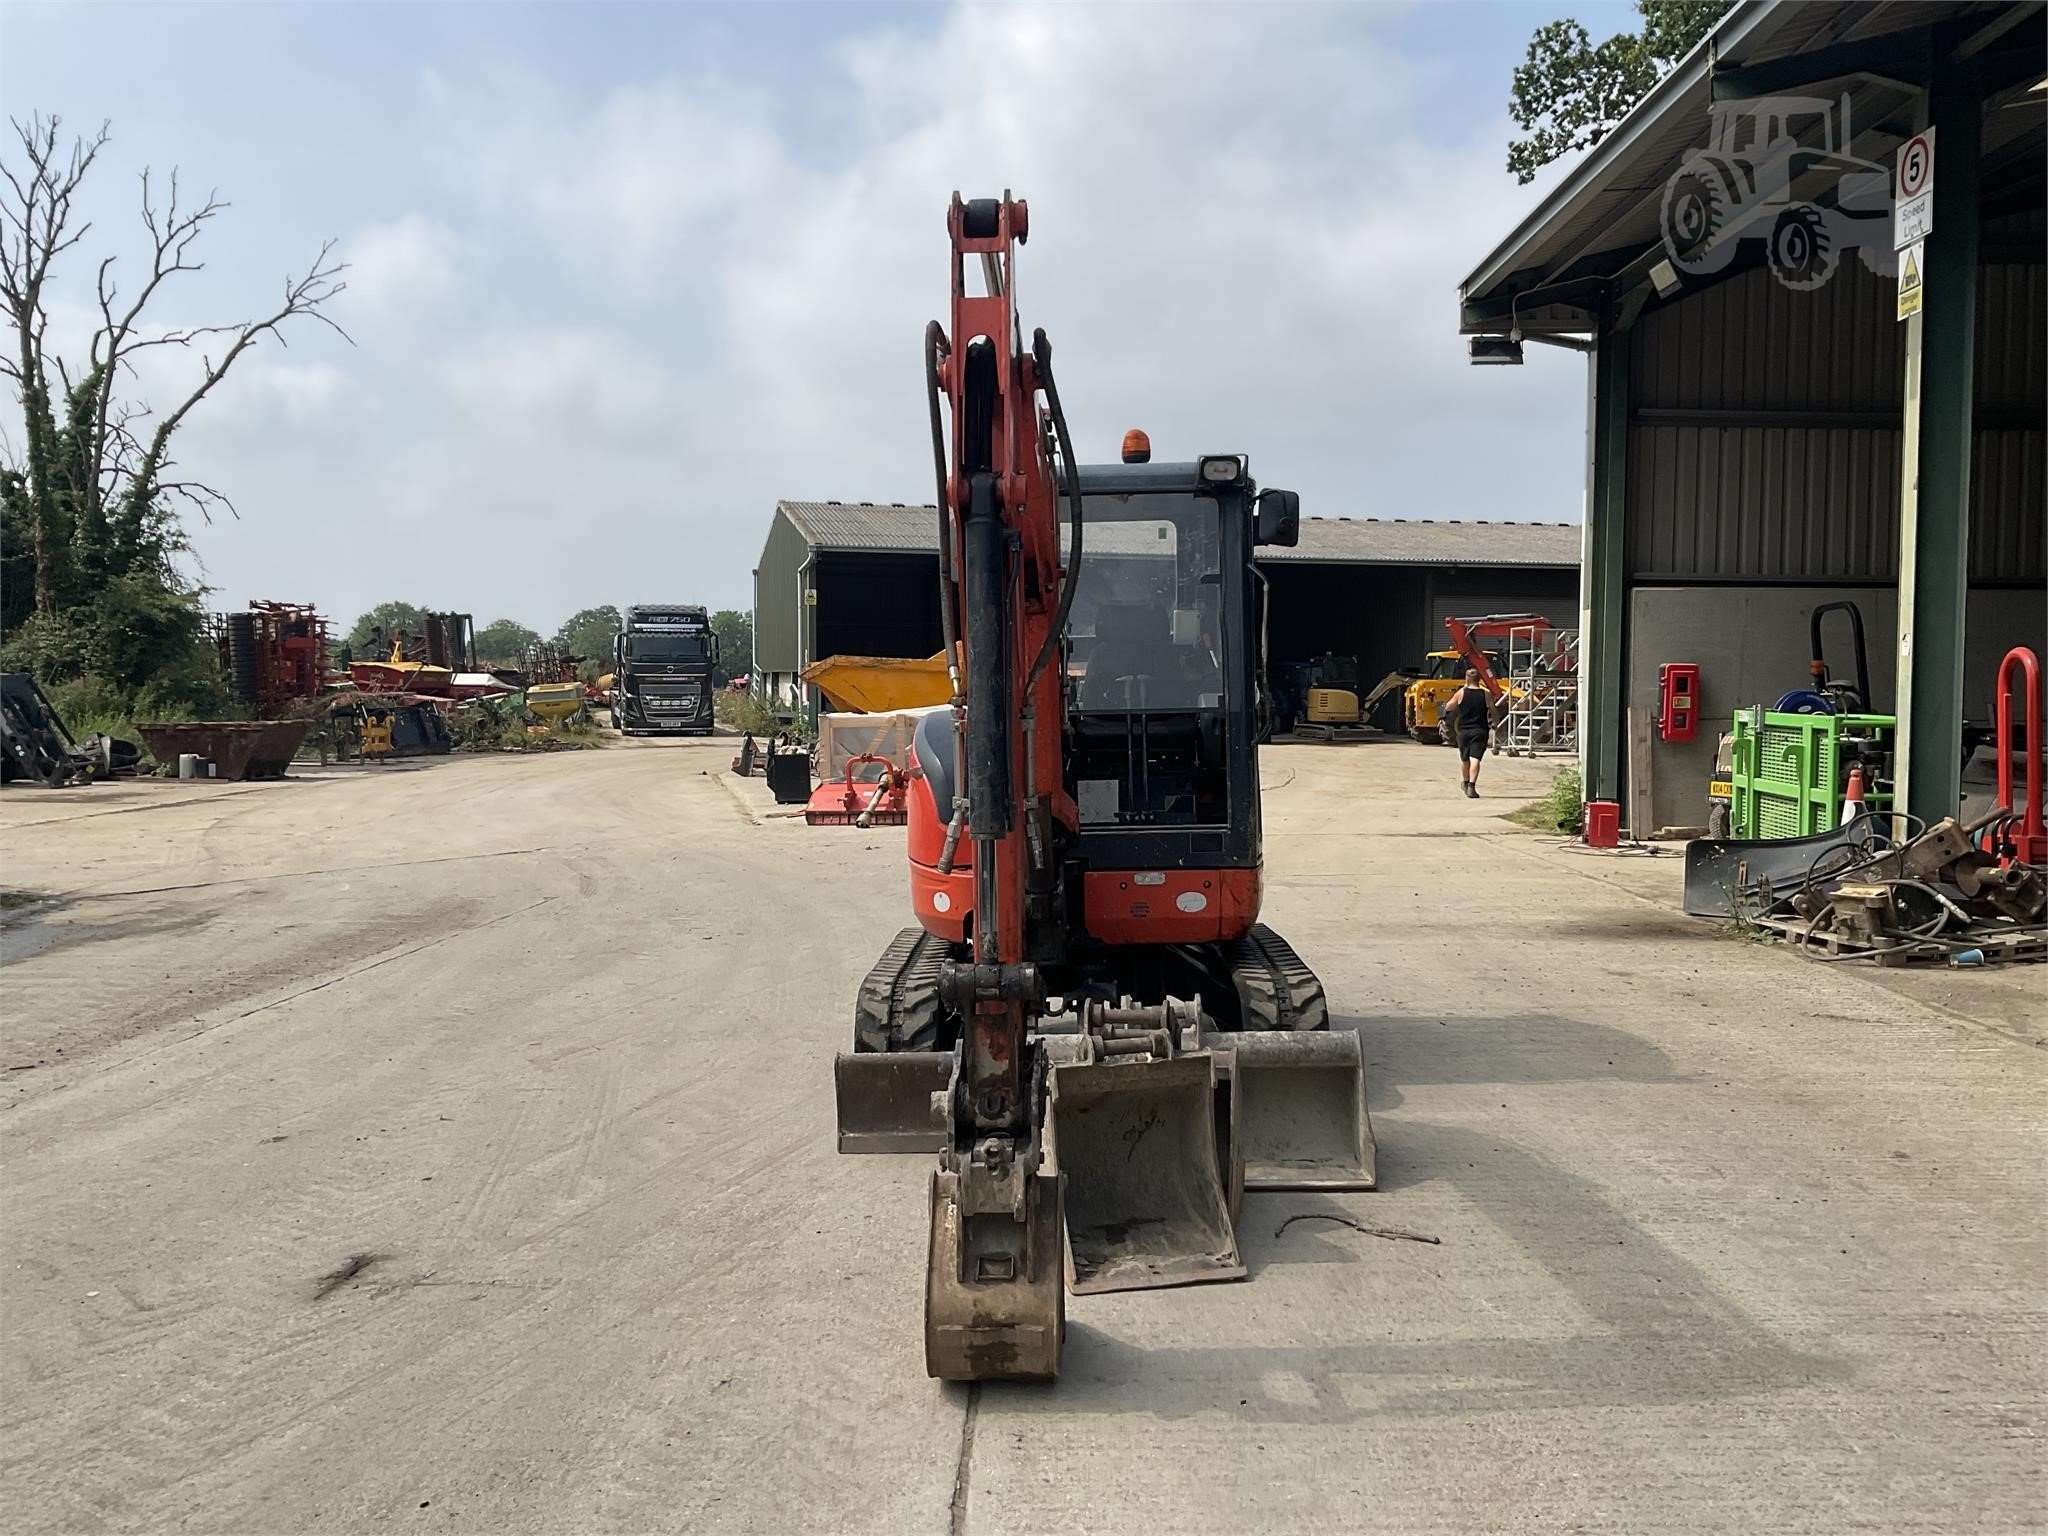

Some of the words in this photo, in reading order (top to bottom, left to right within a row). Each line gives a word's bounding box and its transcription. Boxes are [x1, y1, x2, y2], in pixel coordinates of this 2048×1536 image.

[1909, 152, 1920, 183] 5
[1902, 200, 1925, 222] Speed
[1903, 219, 1923, 238] Limit
